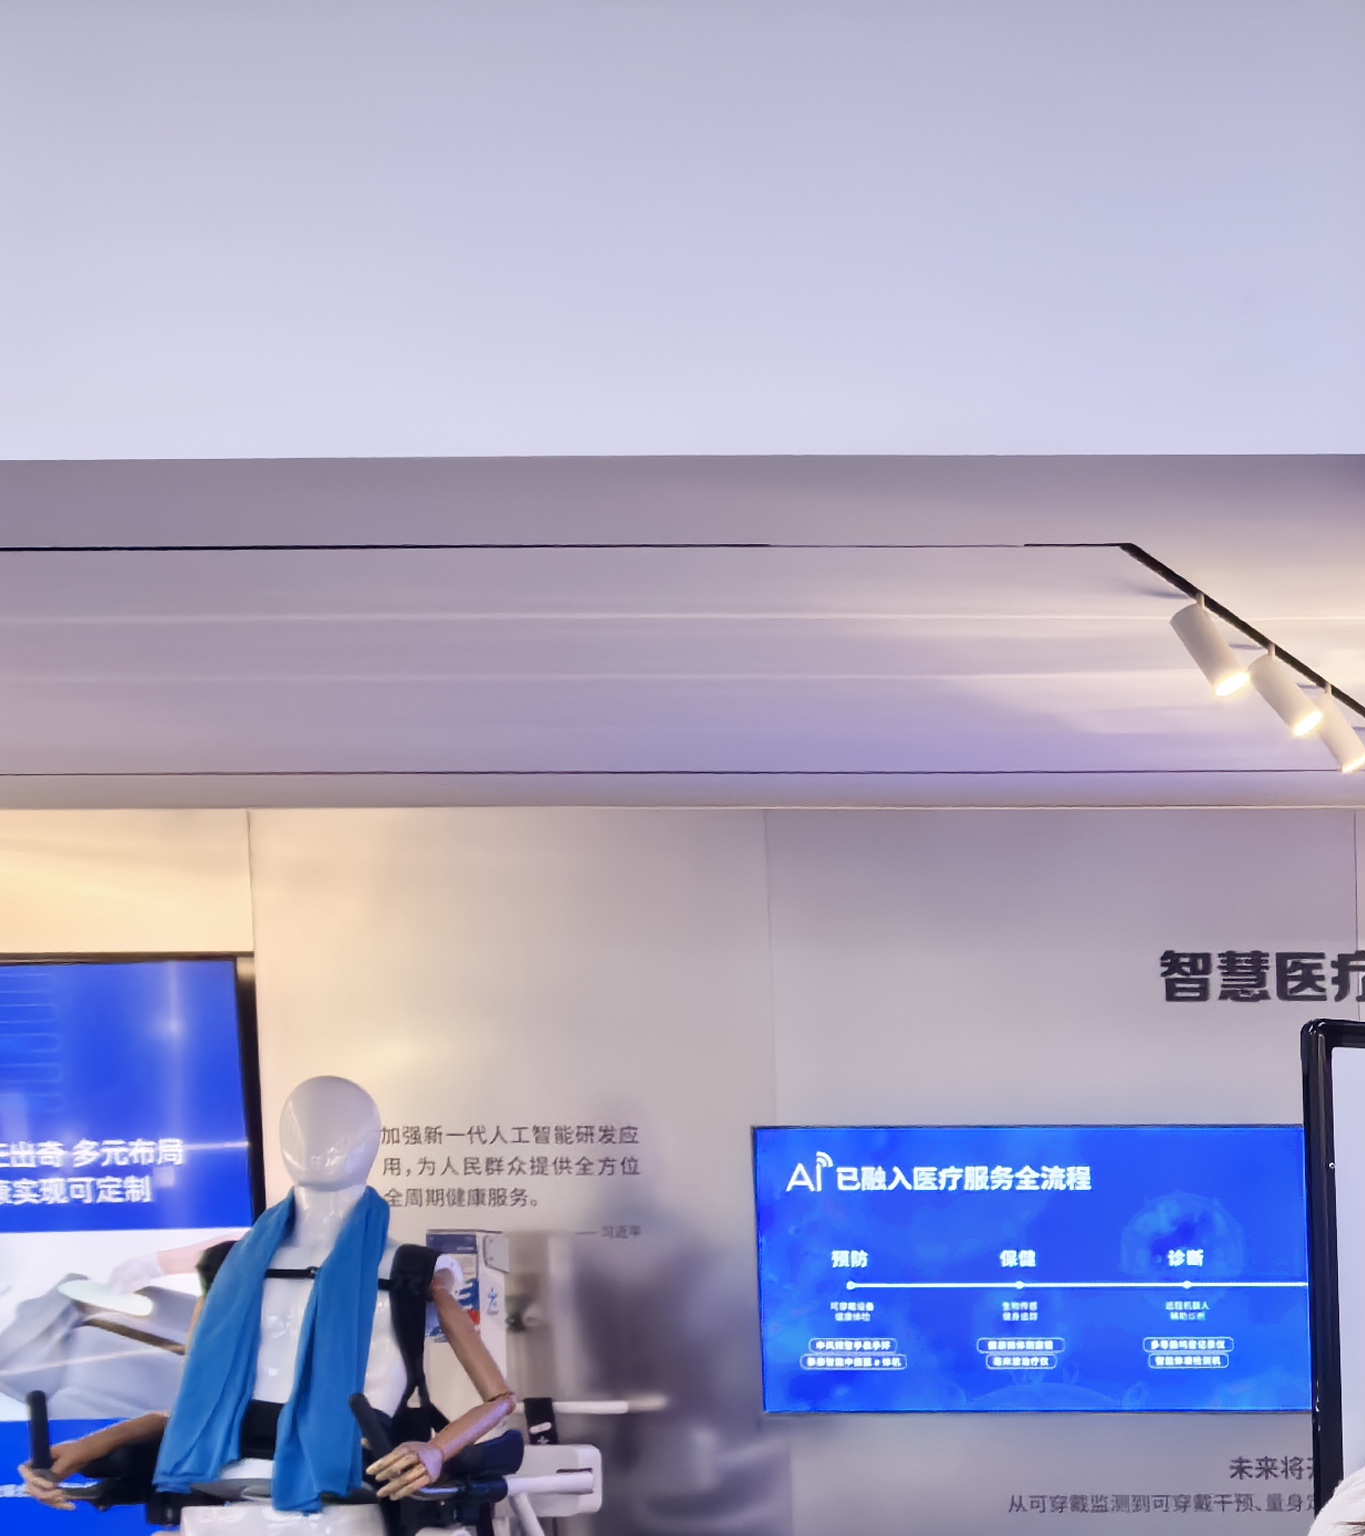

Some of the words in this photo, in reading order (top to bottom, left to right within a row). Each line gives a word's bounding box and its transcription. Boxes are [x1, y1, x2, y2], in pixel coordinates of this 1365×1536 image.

[381, 1125, 640, 1146] 加强新一代人工智能研发应
[72, 1138, 184, 1166] 多元布局
[832, 1250, 868, 1267] 预防
[1000, 1250, 1036, 1267] 保健
[1167, 1249, 1204, 1267] 诊断
